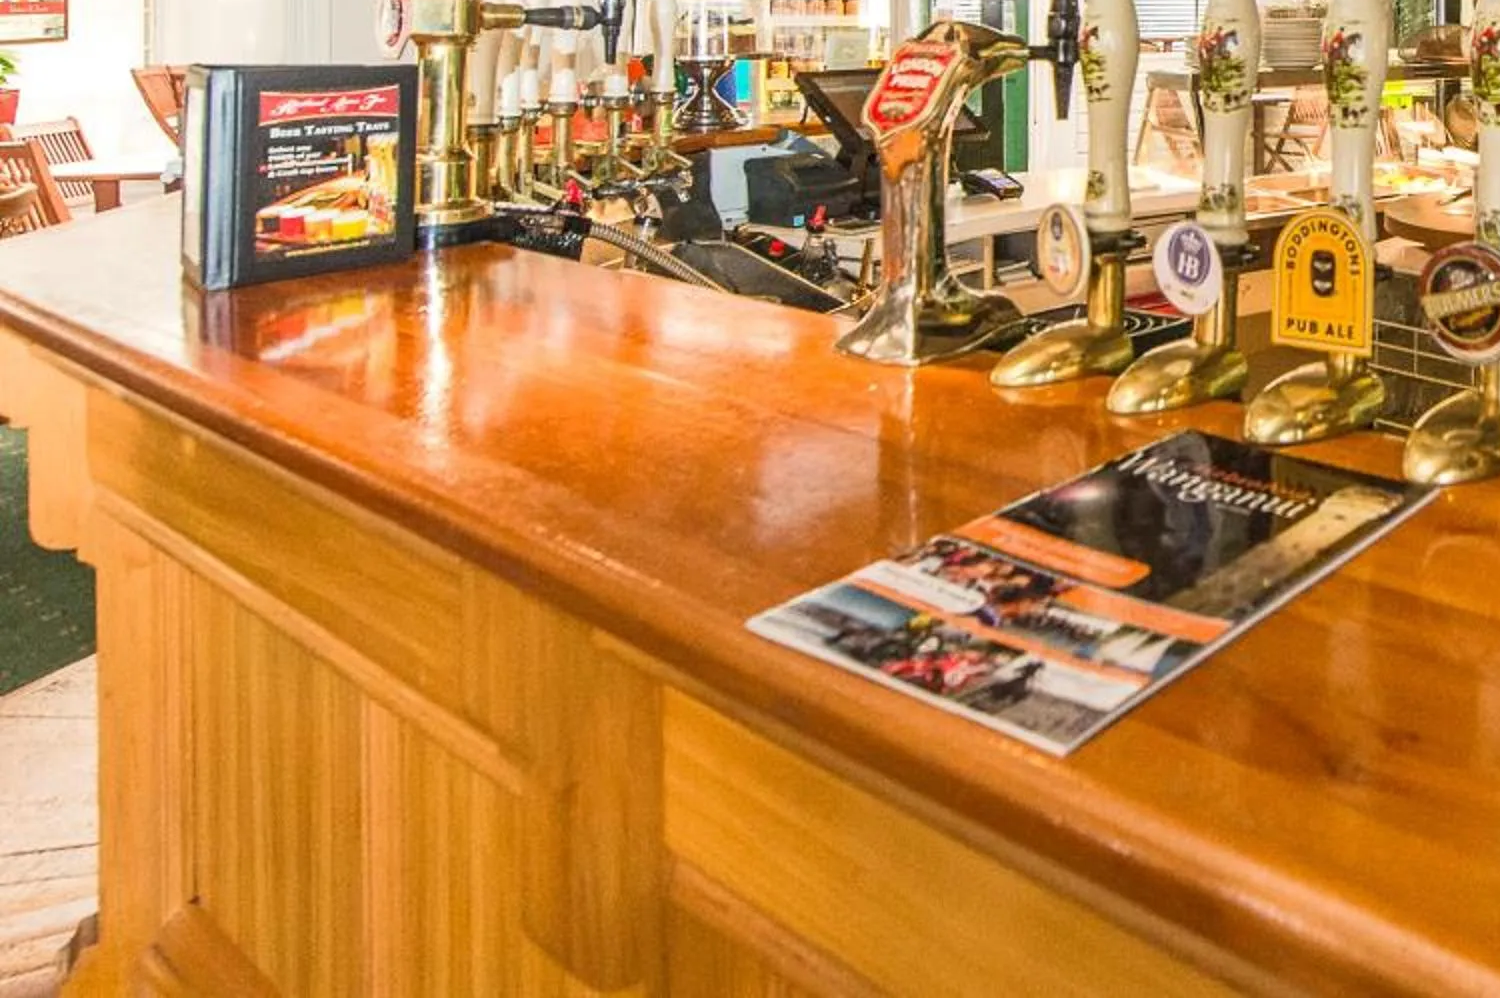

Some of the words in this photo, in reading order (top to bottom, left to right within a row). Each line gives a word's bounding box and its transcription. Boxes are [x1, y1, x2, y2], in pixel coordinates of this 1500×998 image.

[1285, 219, 1361, 278] BODDINGTONS
[1177, 254, 1200, 280] HB
[1285, 317, 1319, 336] PUB
[1325, 320, 1355, 341] ALE
